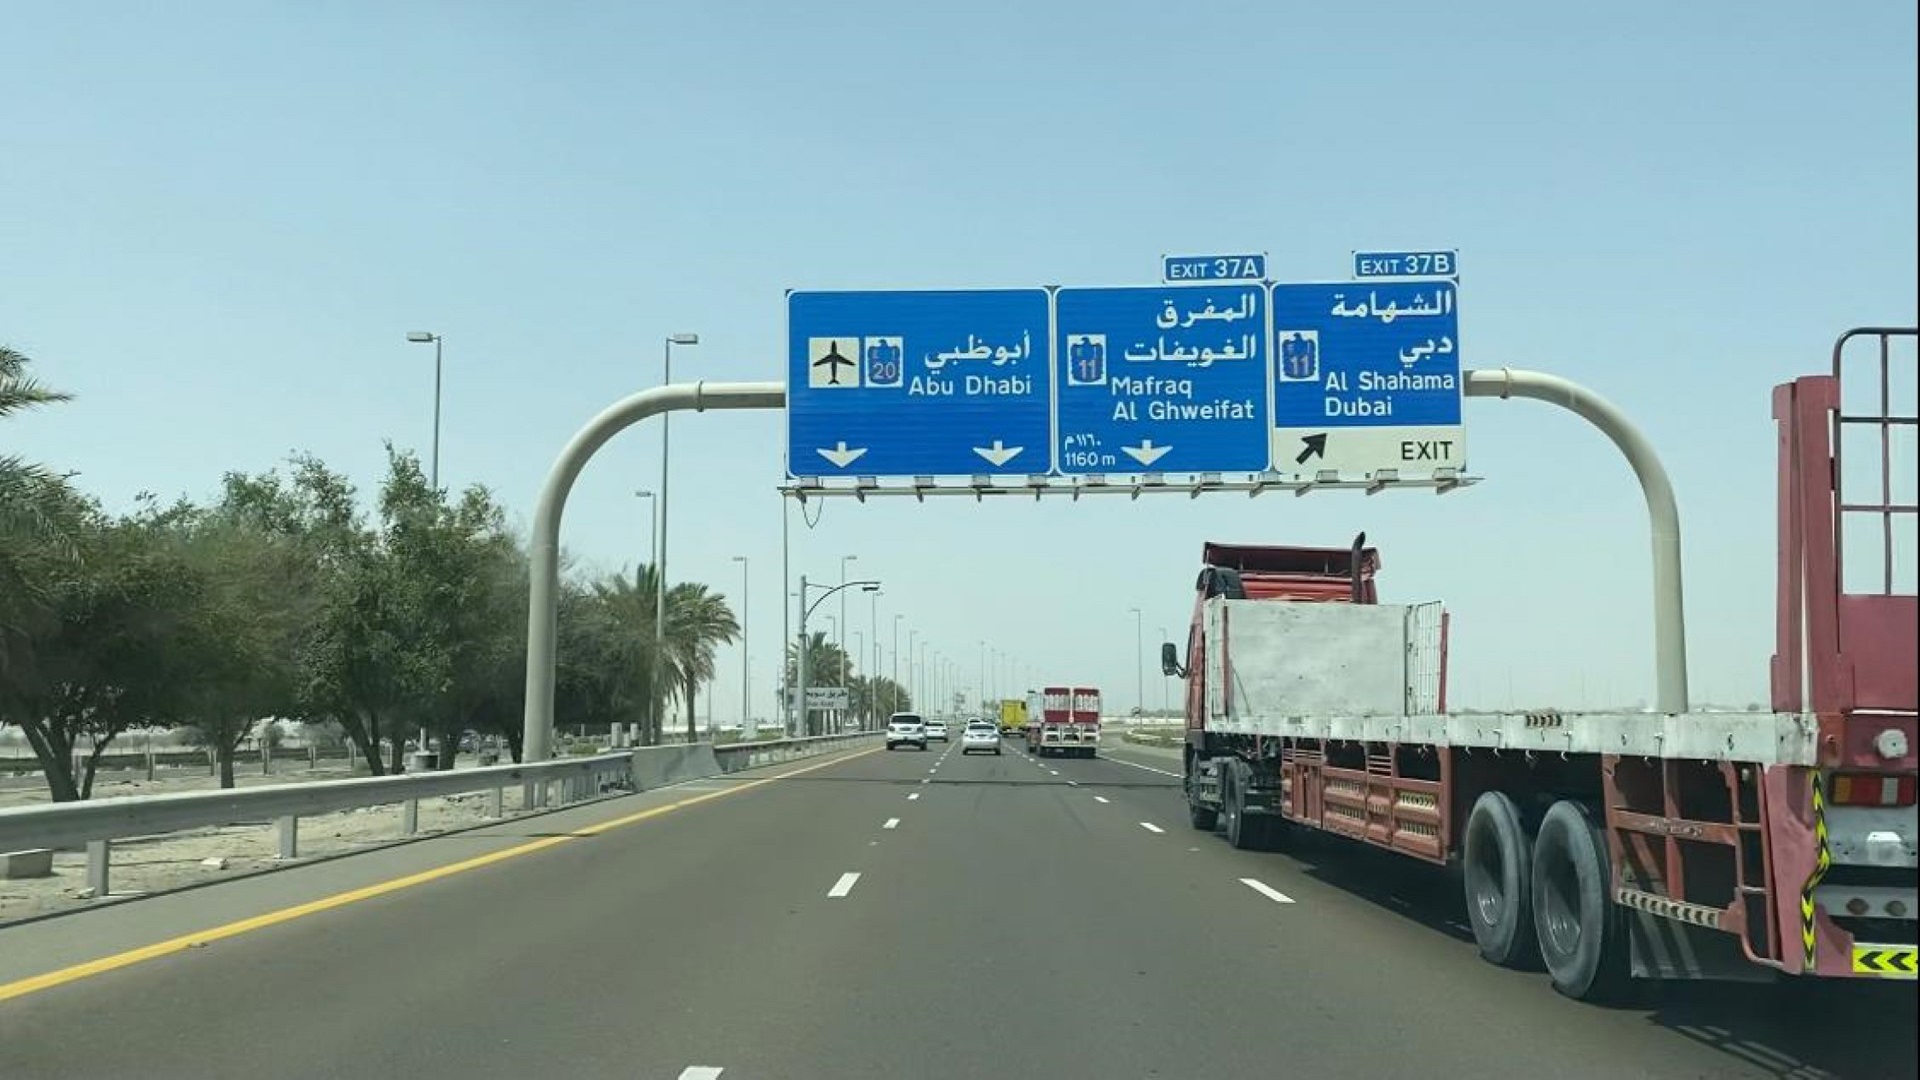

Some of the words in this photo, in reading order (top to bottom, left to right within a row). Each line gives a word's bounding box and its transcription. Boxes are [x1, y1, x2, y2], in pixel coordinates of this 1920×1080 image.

[1170, 263, 1208, 279] EXIT
[1213, 258, 1259, 278] 37A
[1361, 259, 1400, 275] EXIT
[1405, 254, 1451, 274] 37B
[1156, 293, 1256, 328] المفرق
[1331, 290, 1452, 323] الشهامة
[1124, 335, 1257, 367] الغويفات
[1399, 336, 1453, 368] دبي
[872, 362, 896, 380] 20
[1079, 360, 1096, 379] 11
[1290, 355, 1309, 375] 11
[909, 376, 953, 395] Abu
[966, 375, 1031, 395] Dhabi
[1111, 376, 1192, 399] Mafraq
[1325, 372, 1348, 391] Al
[1358, 371, 1455, 390] Shahama
[1112, 402, 1138, 420] Al
[1148, 400, 1255, 419] Ghweifat
[1325, 396, 1392, 416] Dubai
[1065, 452, 1098, 466] 1160
[1102, 455, 1116, 466] m
[1401, 441, 1453, 460] EXIT
